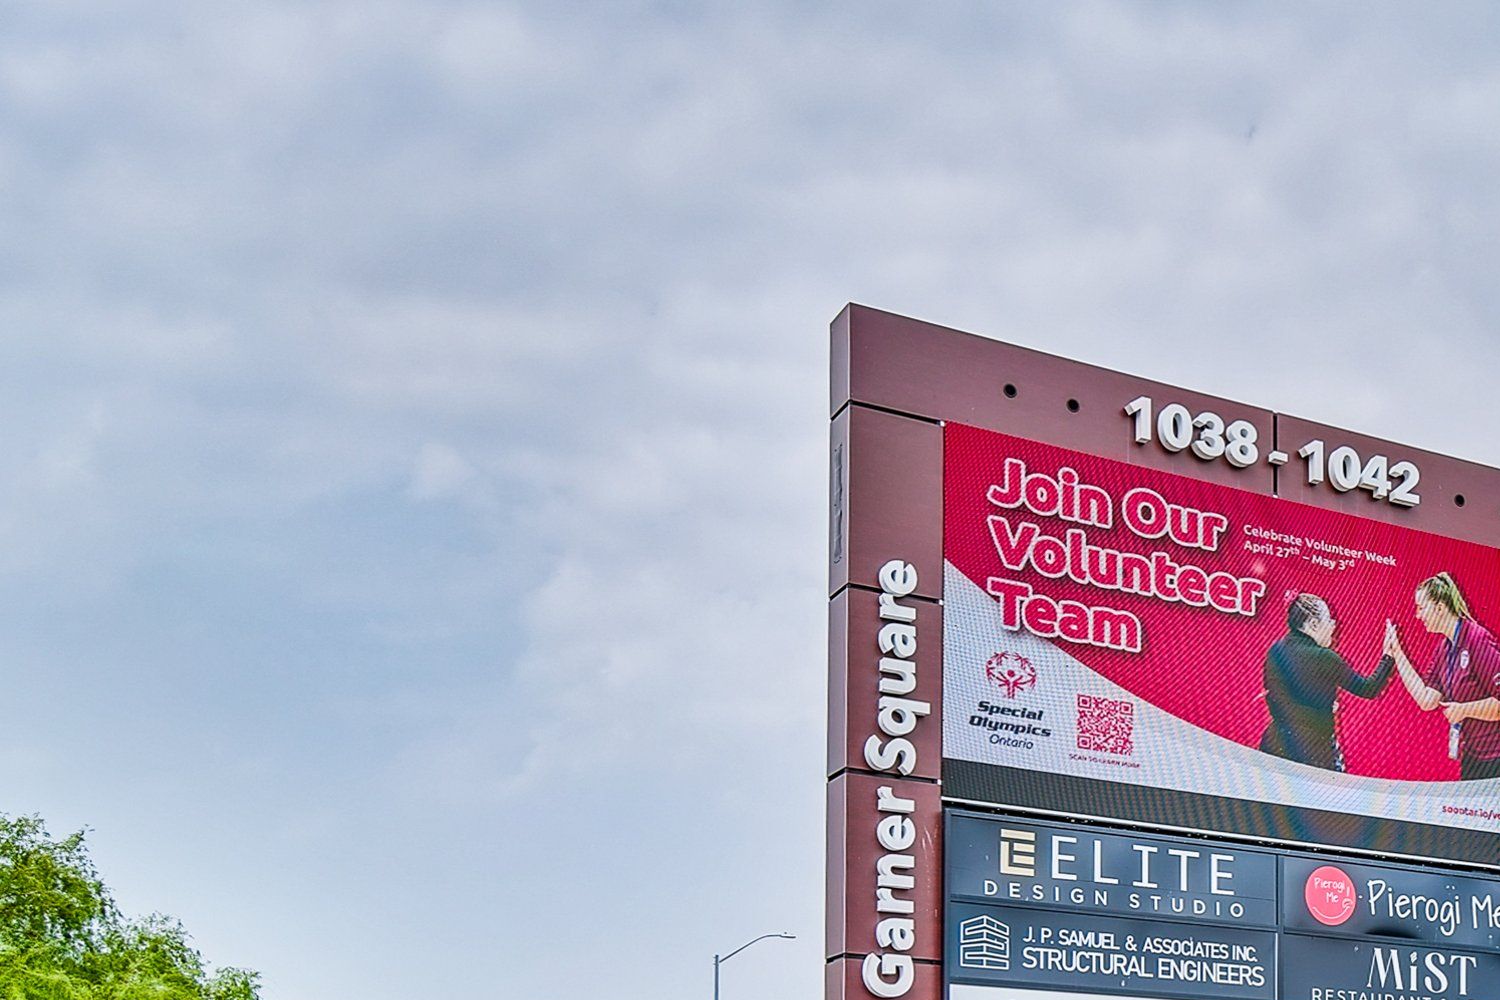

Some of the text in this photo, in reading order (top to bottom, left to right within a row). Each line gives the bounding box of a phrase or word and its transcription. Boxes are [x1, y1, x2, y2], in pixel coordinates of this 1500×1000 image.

[1124, 396, 1420, 507] 1038 - 1042
[986, 457, 1228, 552] Join Our
[1243, 525, 1397, 566] Celebrate Volunteer Week
[1244, 541, 1274, 555] April
[1312, 555, 1336, 570] May
[987, 516, 1265, 617] Volunteer
[987, 578, 1142, 653] Team
[969, 715, 1051, 737] Olympics
[977, 700, 1043, 721] Special
[989, 733, 1034, 750] Ontario
[862, 559, 931, 998] Garner Square
[1051, 834, 1235, 896] ELITE
[1314, 877, 1345, 893] Pierogi
[984, 879, 1244, 918] DESIGN STUDIO
[1367, 879, 1461, 936] Pierogi
[1022, 926, 1258, 962] J. P. SAMUEL & ASSOCIATES INC.
[1022, 948, 1265, 987] STRUCTURAL ENGINEERS
